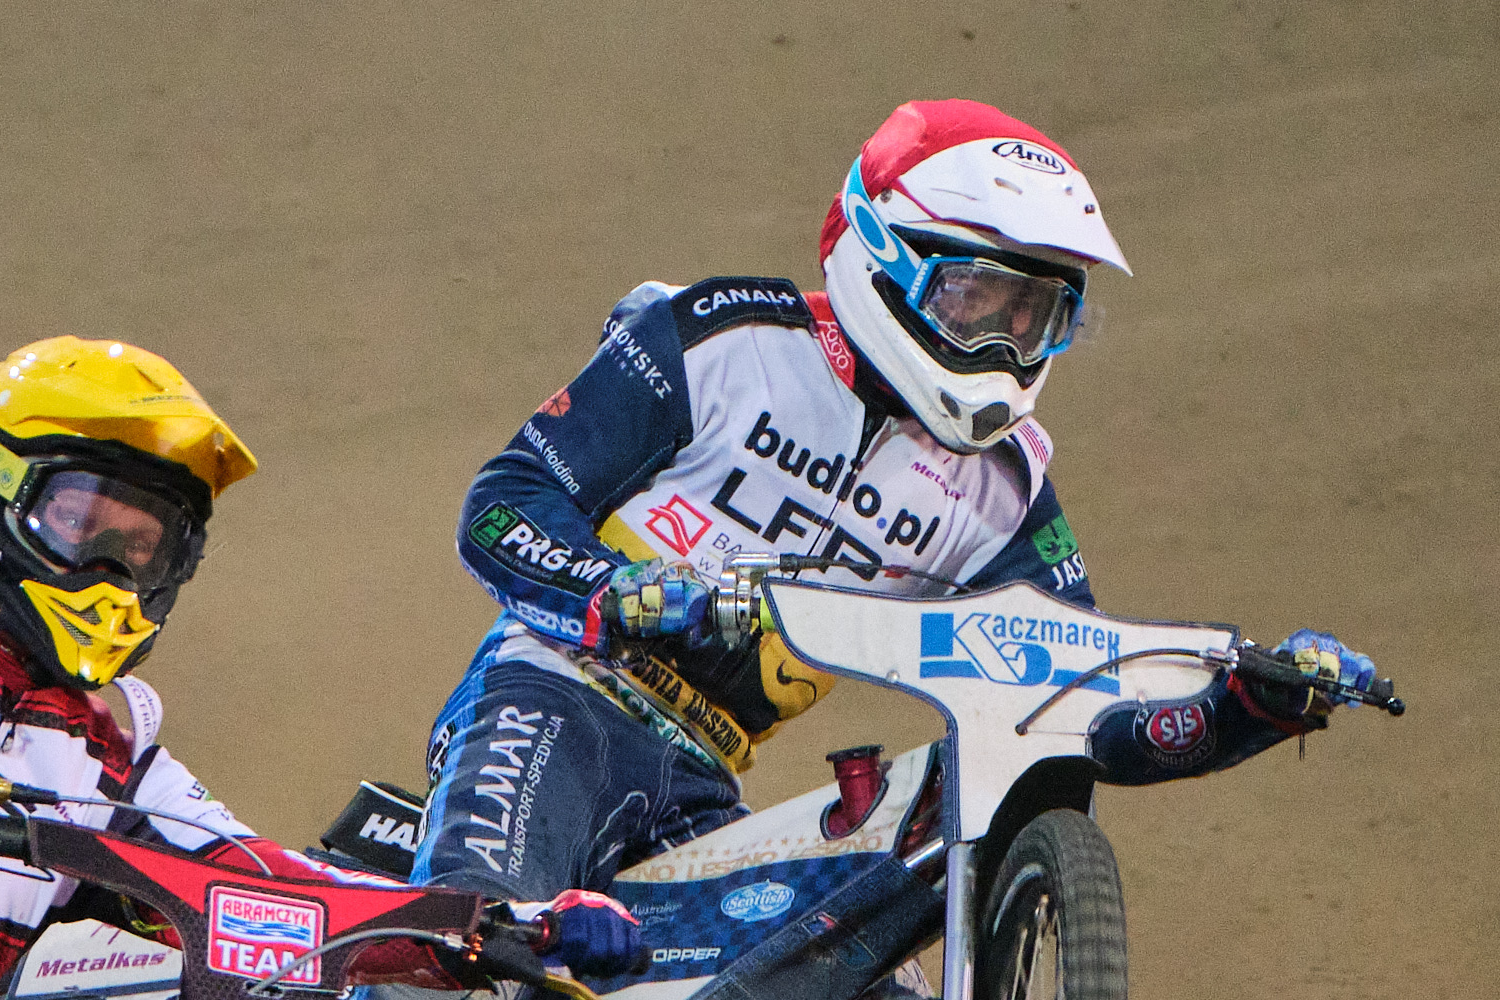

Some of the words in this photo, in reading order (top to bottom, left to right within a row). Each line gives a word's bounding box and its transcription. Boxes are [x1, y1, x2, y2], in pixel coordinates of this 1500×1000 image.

[1000, 143, 1059, 169] Arai
[693, 289, 797, 317] CANAL+
[500, 523, 611, 582] PRG-M
[464, 705, 543, 873] ALMAR
[222, 900, 311, 928] ABRAMCZYK
[36, 951, 167, 978] Metalkas
[215, 939, 314, 981] TEAM
[652, 948, 721, 963] OPPER
